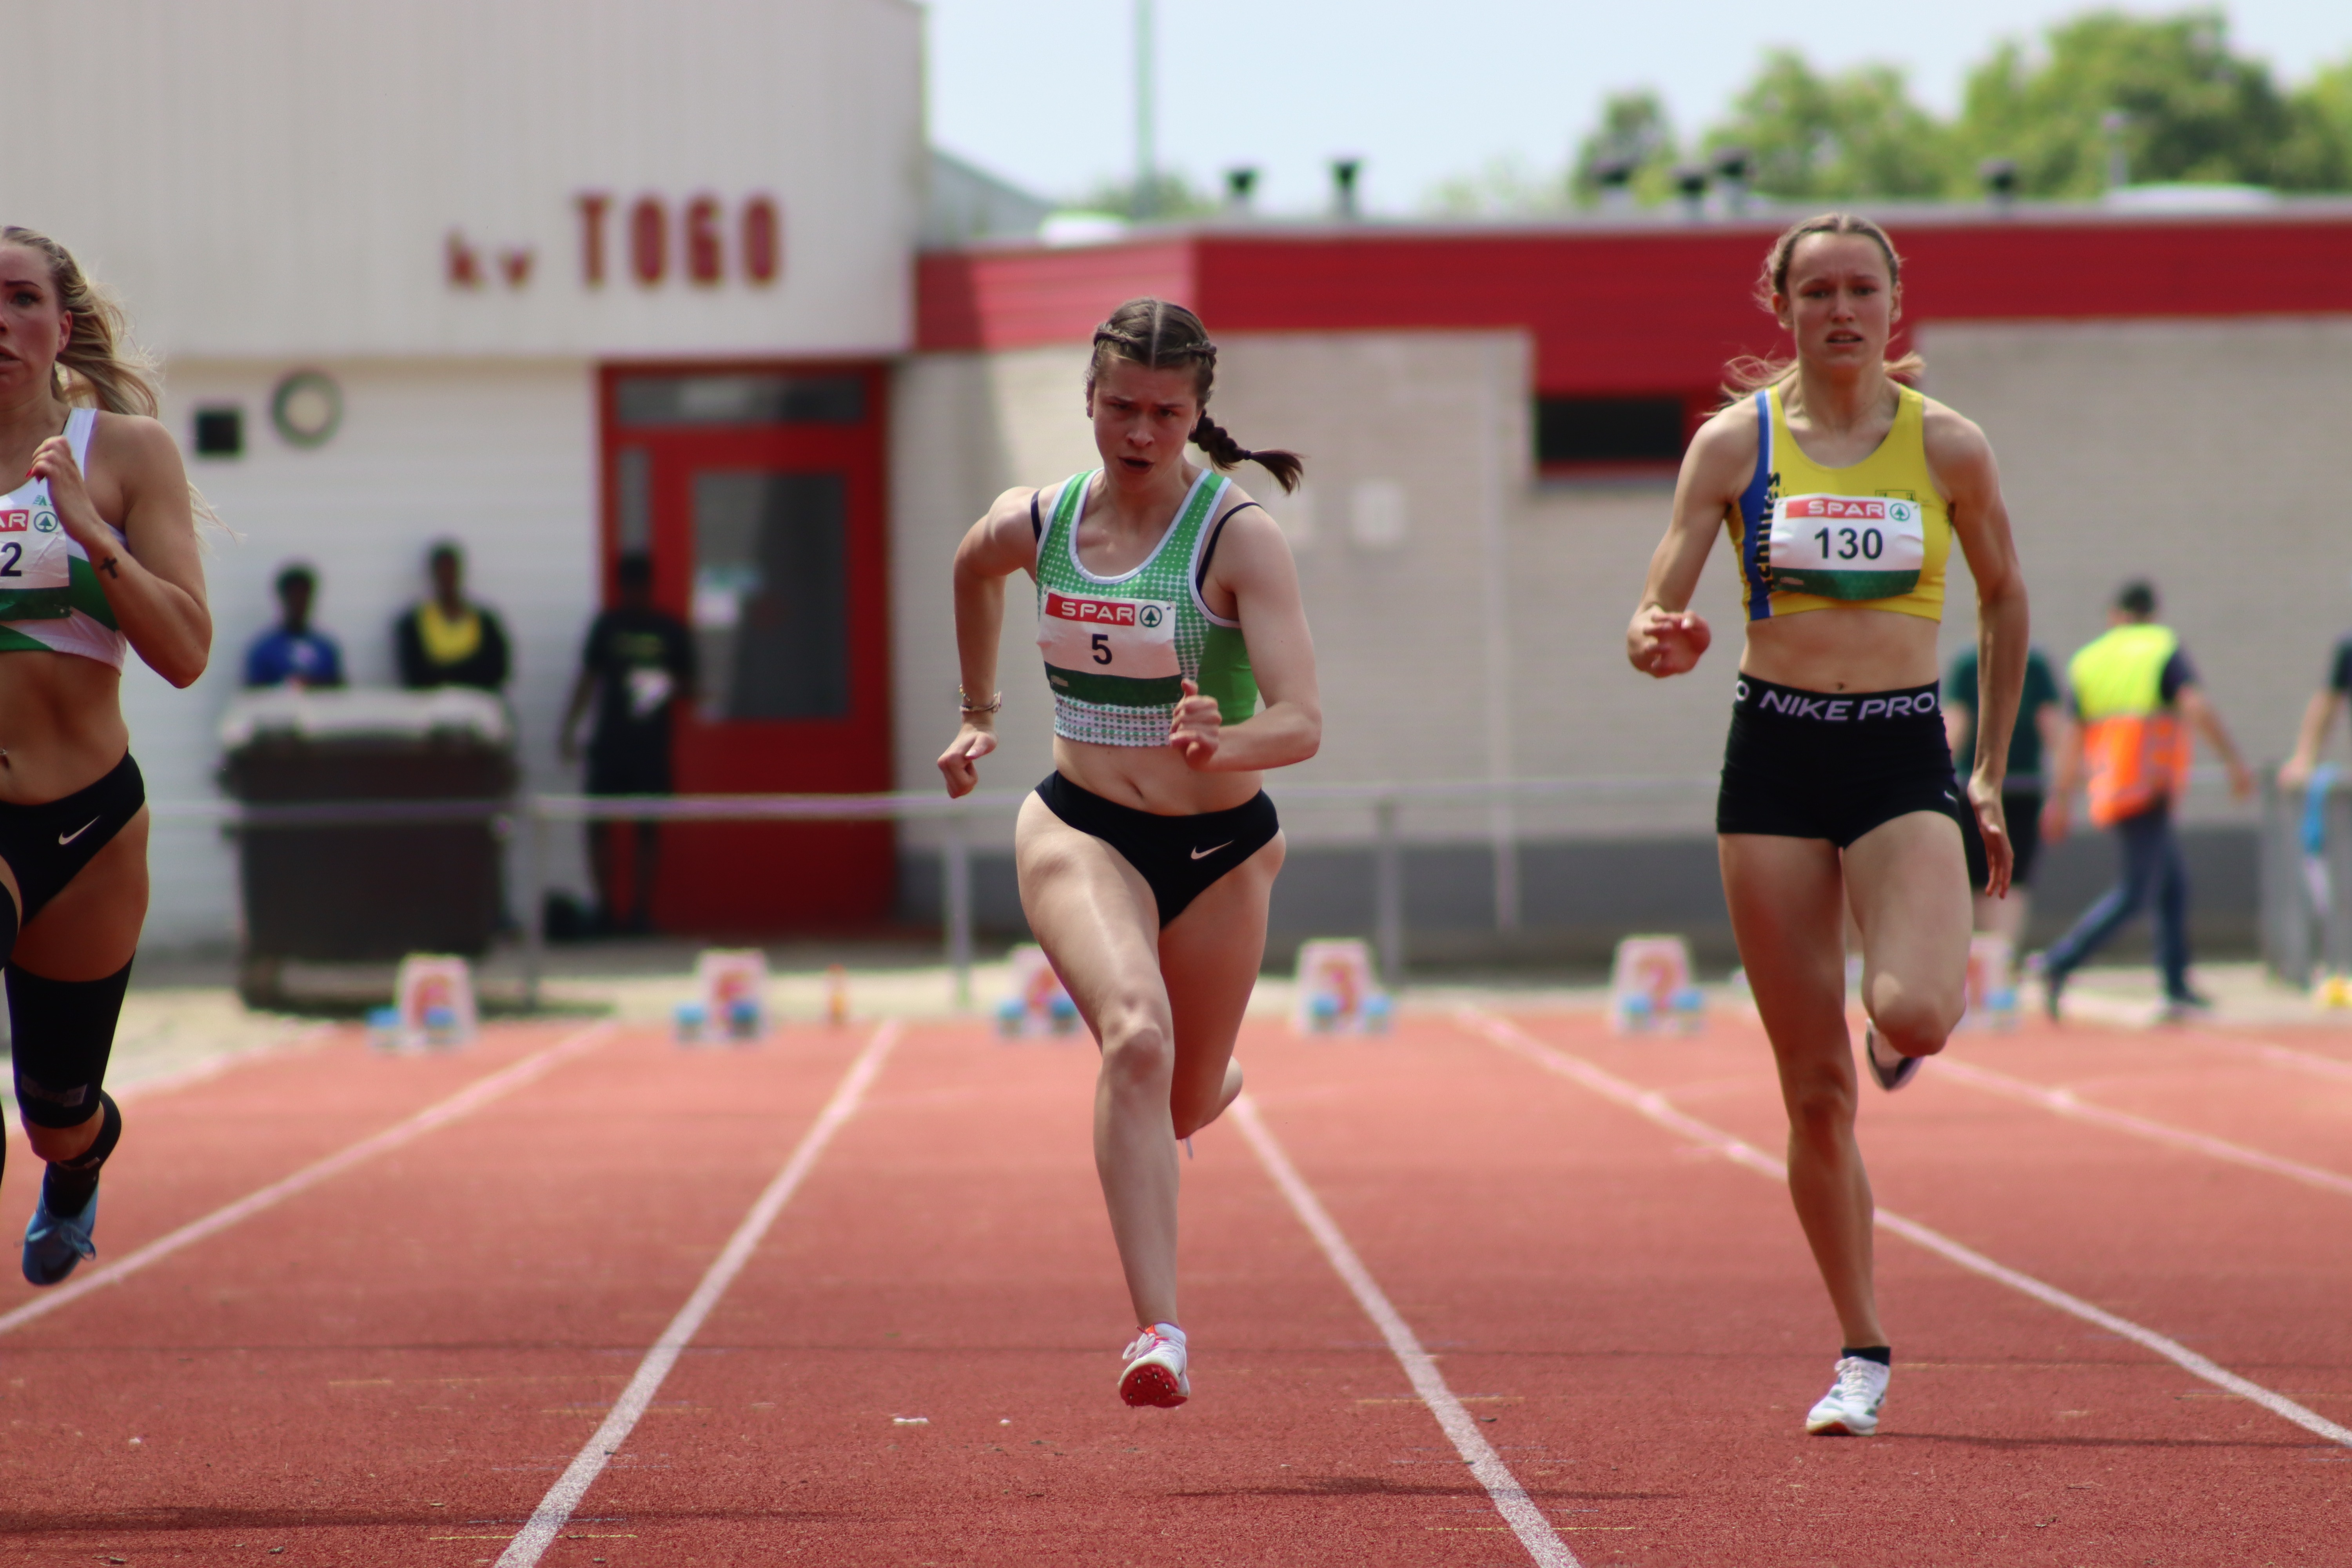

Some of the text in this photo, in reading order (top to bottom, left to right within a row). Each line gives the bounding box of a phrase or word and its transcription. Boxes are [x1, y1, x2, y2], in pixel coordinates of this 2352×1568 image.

[0, 512, 26, 528] R
[1808, 500, 1884, 516] SPAR
[1814, 527, 1883, 560] 130
[0, 542, 22, 577] 2
[1061, 601, 1134, 622] SPAR
[1091, 633, 1112, 665] 5
[1759, 690, 1853, 720] NIKE
[1857, 691, 1935, 720] PRO
